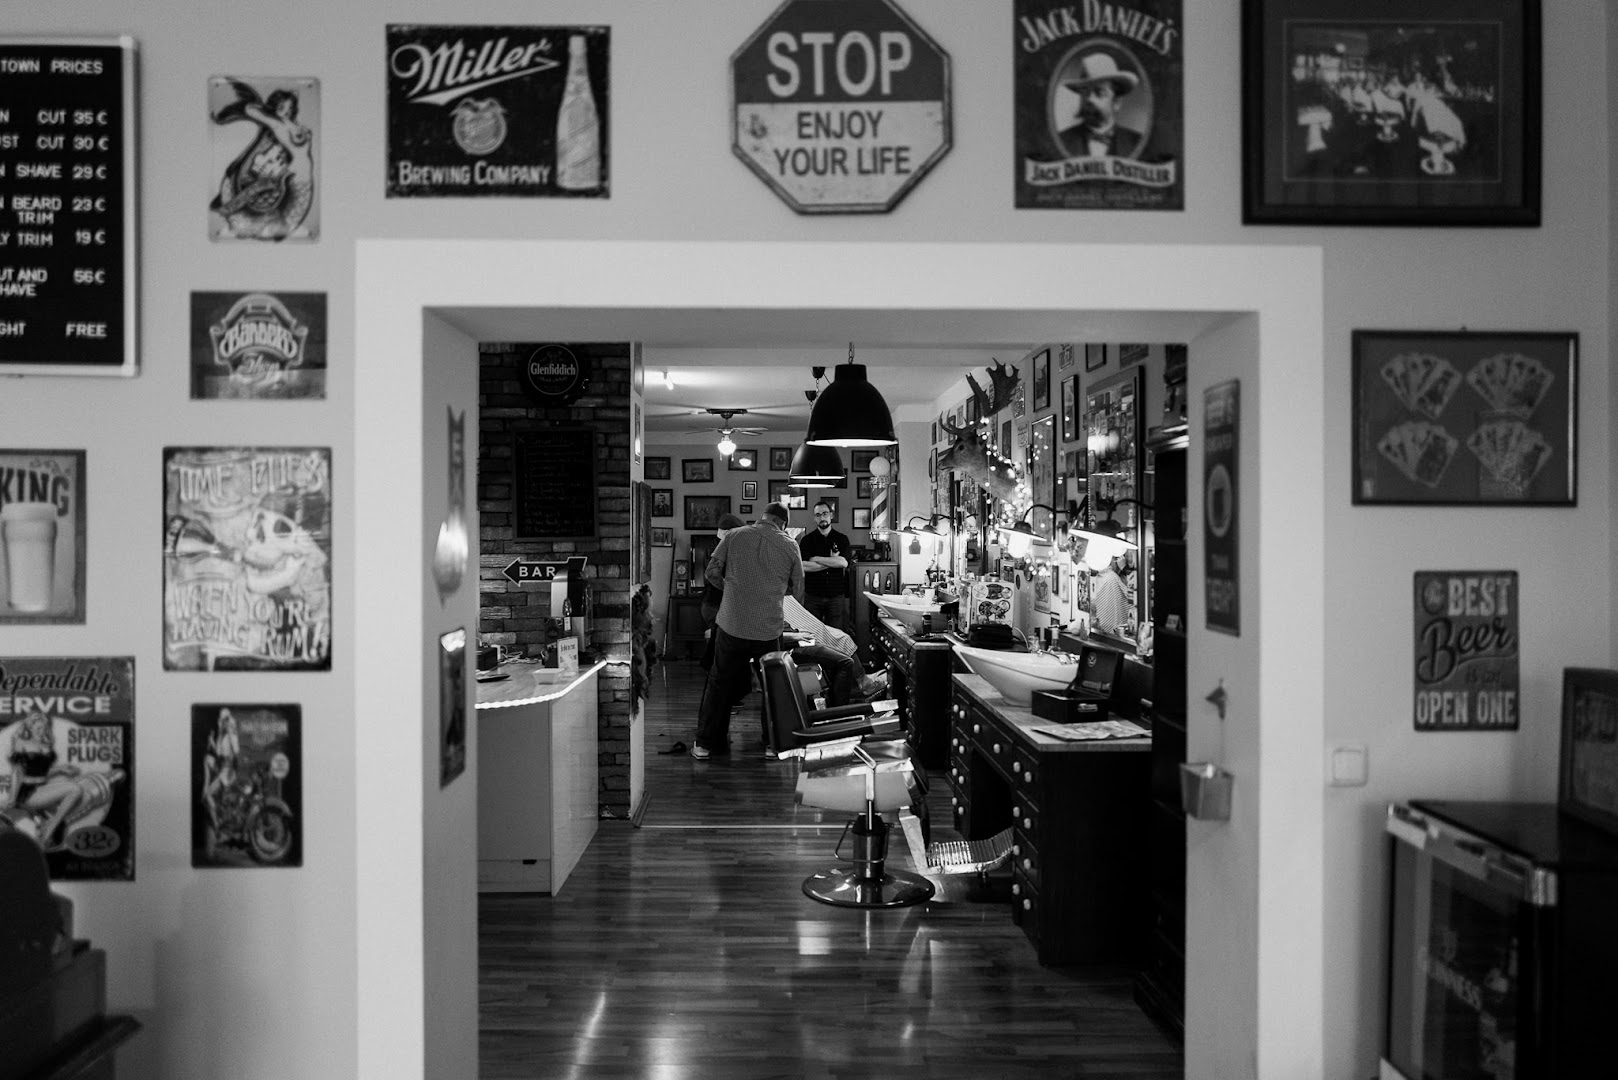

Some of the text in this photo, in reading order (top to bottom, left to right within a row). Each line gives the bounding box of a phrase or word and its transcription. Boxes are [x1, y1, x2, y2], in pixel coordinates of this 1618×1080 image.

[1020, 0, 1178, 55] JACK DANIEL'S
[0, 59, 103, 74] TOWN PRICES
[390, 37, 552, 97] Miller
[767, 31, 912, 98] STOP
[37, 111, 66, 125] CUT
[74, 112, 94, 125] 35
[797, 111, 883, 140] ENJOY
[0, 136, 20, 149] ST
[36, 136, 66, 150] CUT
[74, 137, 94, 151] 30
[774, 146, 912, 178] YOUR LIFE
[16, 165, 62, 179] SHAVE
[72, 166, 93, 180] 29
[400, 160, 551, 186] BREWING COMPANY
[1033, 164, 1059, 181] JACK
[12, 197, 62, 211] BEARD
[72, 198, 92, 212] 23
[18, 211, 54, 225] TRIM
[17, 232, 53, 246] TRIM
[75, 231, 92, 245] 19
[17, 269, 48, 283] AND
[65, 323, 107, 338] FREE
[530, 362, 576, 376] Glenfiddich
[519, 566, 556, 578] BAR
[1447, 577, 1511, 616] BEST
[1417, 616, 1516, 684] Beer
[1416, 690, 1516, 725] OPEN ONE
[68, 728, 120, 744] SPARK
[68, 746, 121, 763] PLUGS
